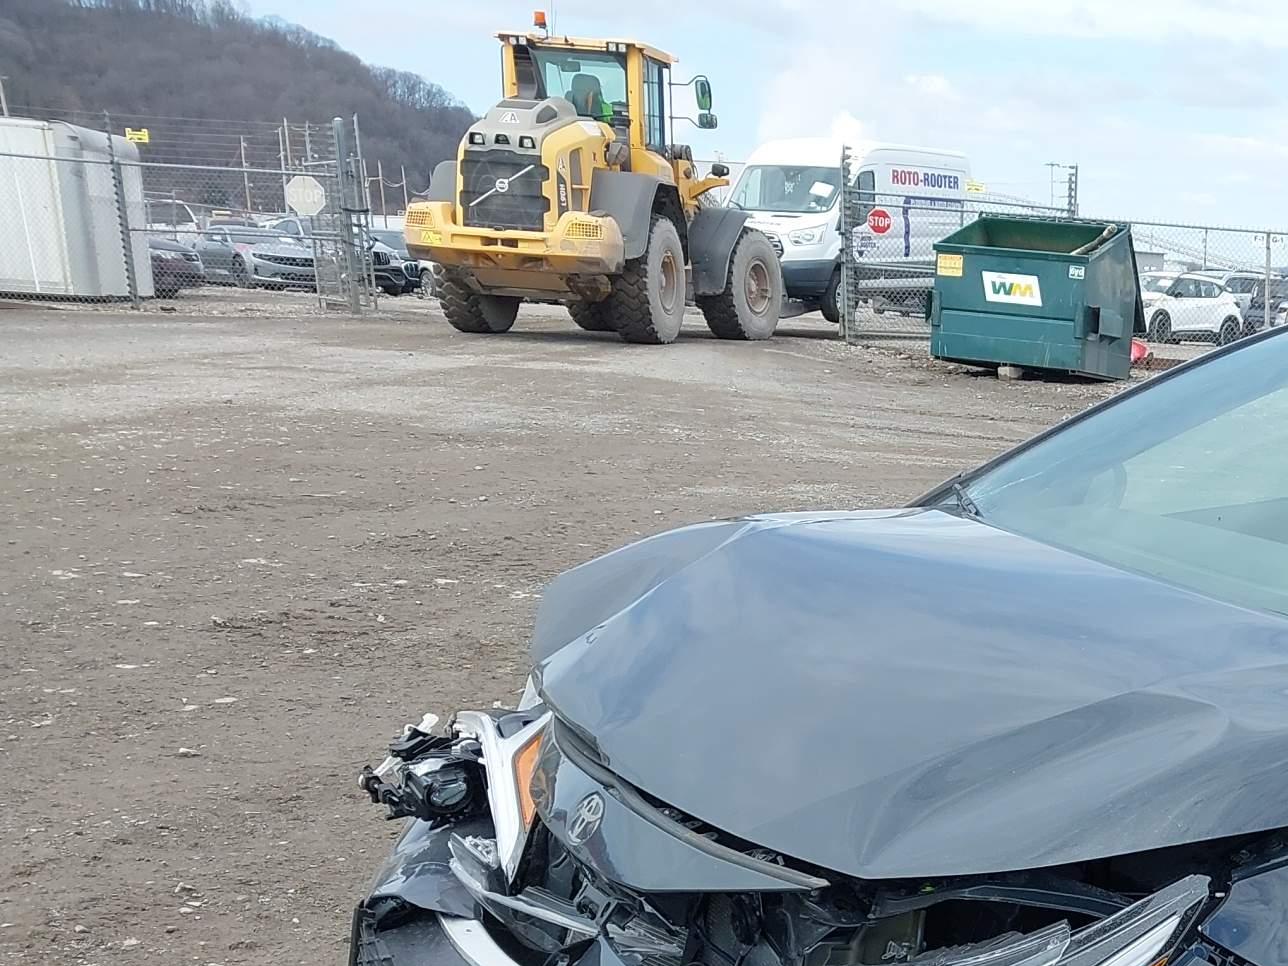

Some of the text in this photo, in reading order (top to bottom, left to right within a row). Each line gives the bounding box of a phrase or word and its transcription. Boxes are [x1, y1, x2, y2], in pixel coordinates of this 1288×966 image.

[891, 168, 960, 190] ROTO-ROOTER
[288, 188, 322, 202] STOP
[868, 215, 891, 227] STOP
[991, 280, 1034, 298] WM
